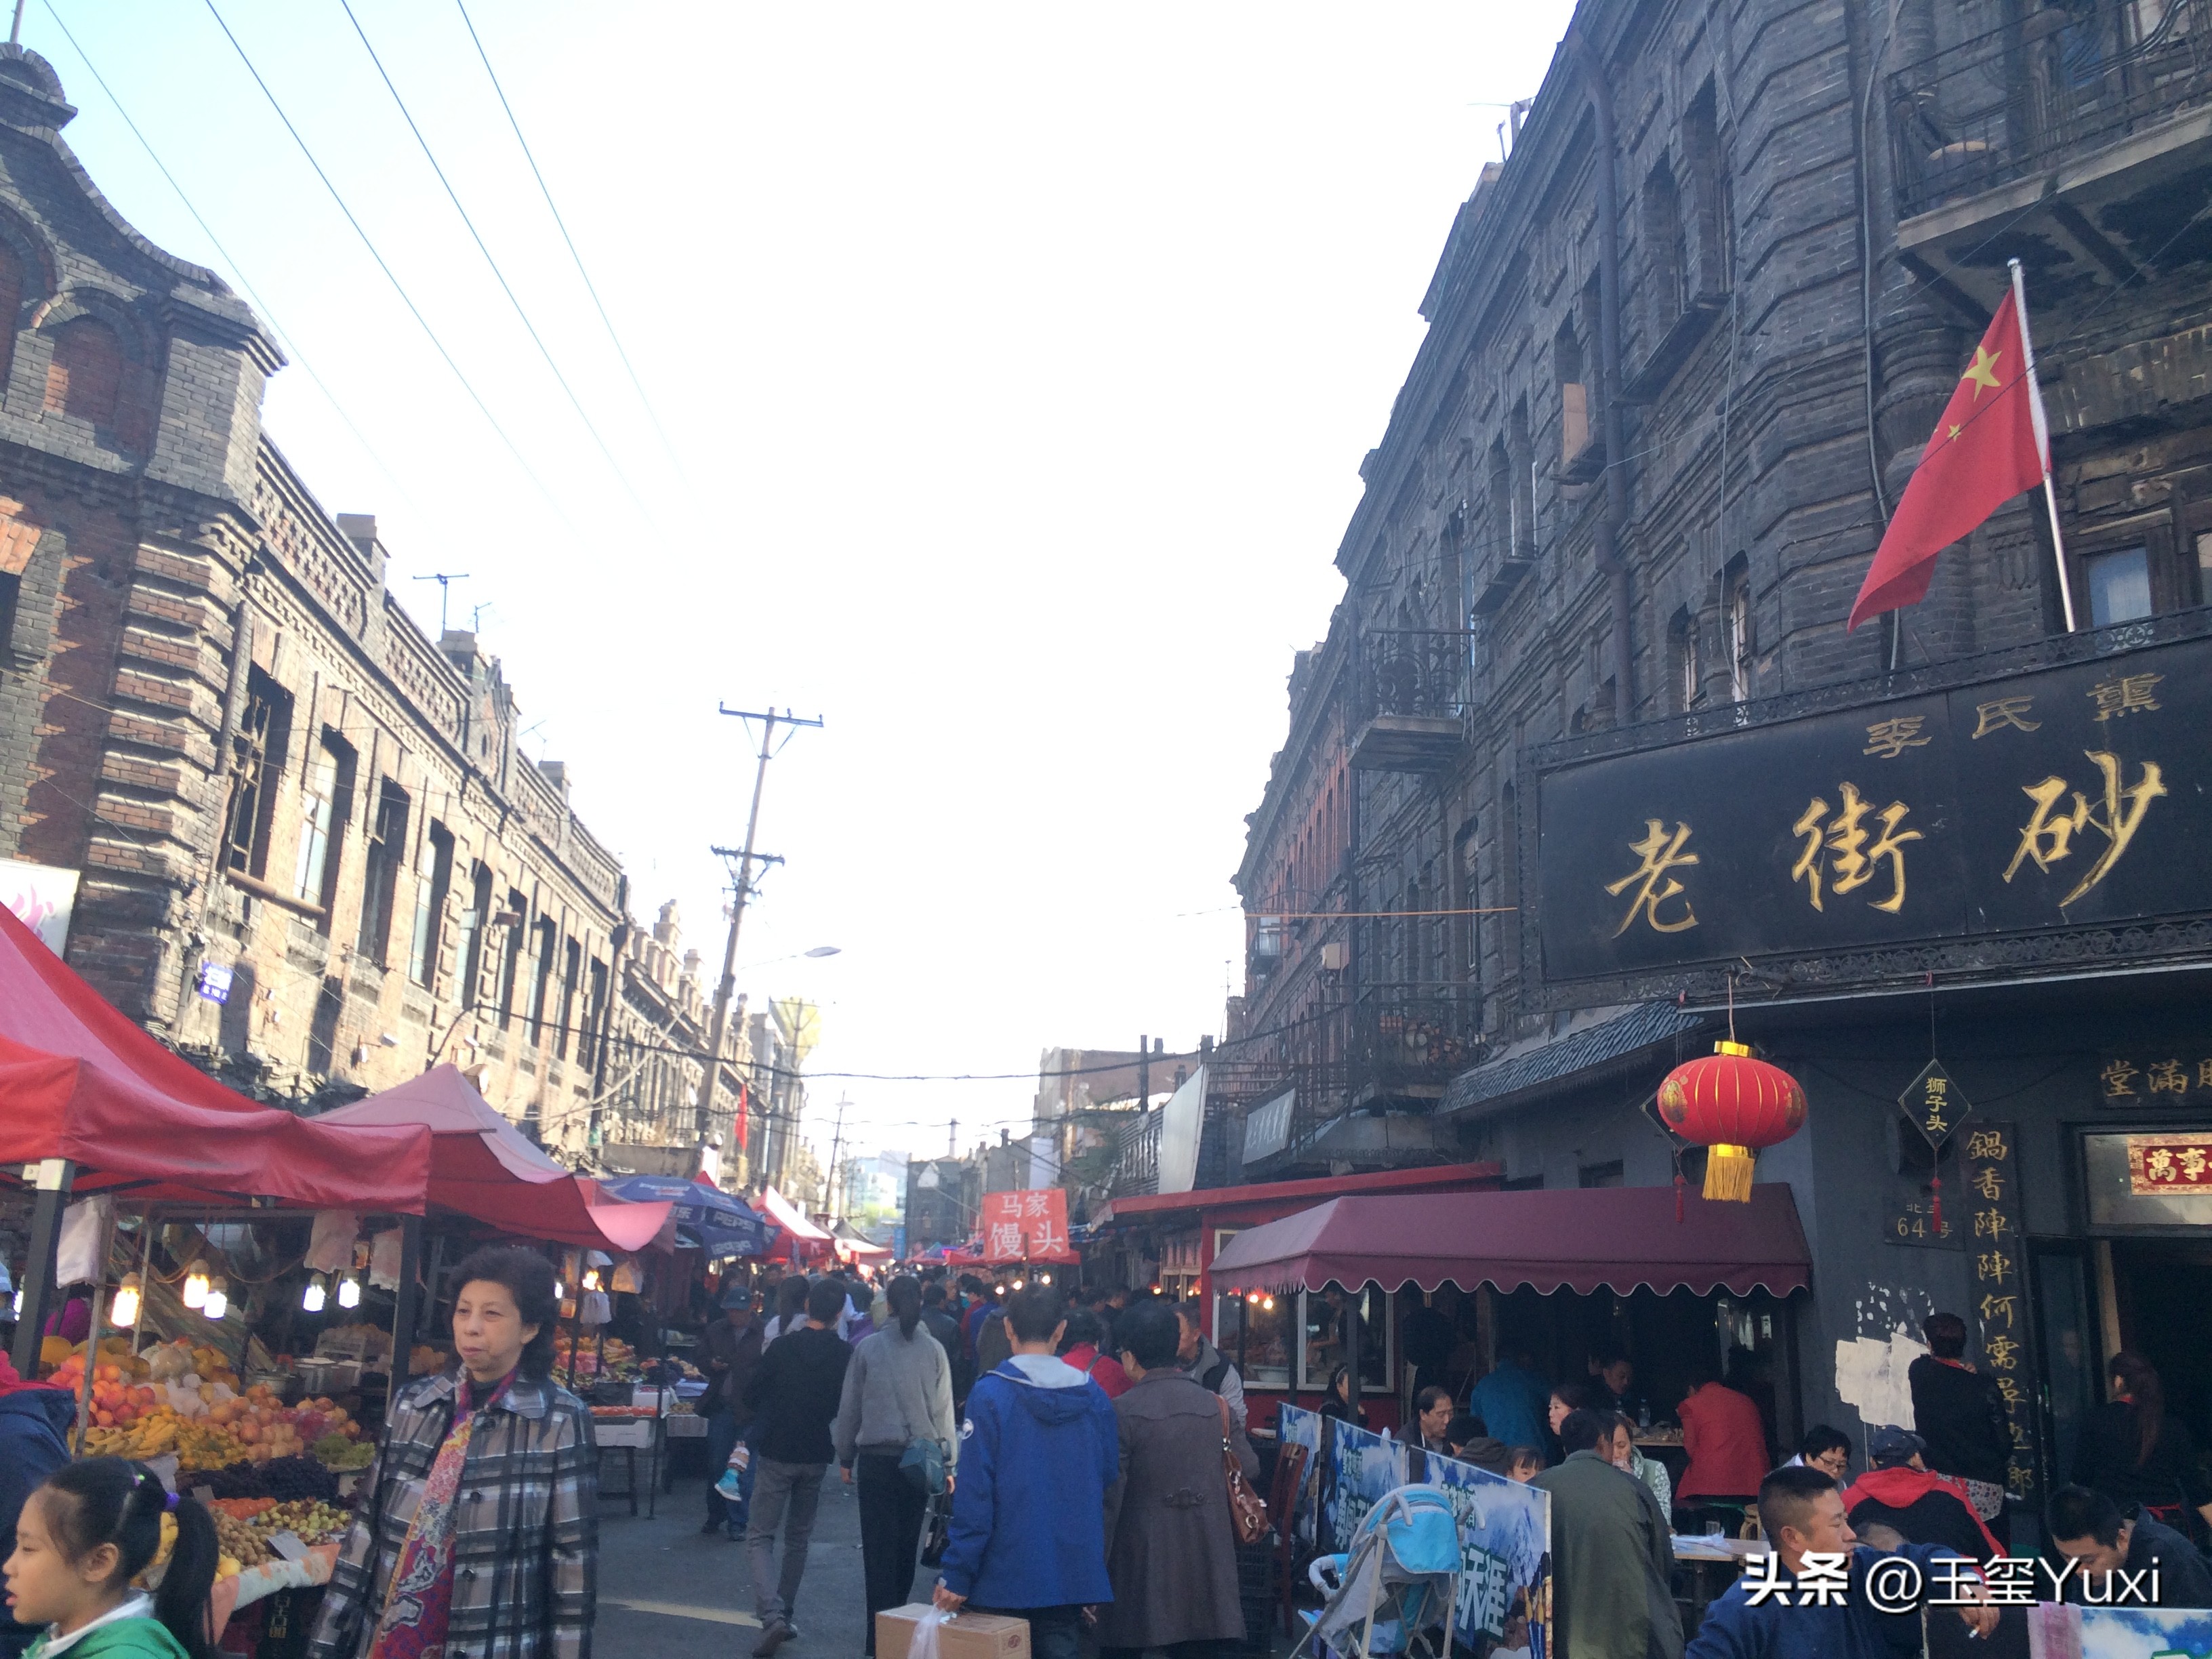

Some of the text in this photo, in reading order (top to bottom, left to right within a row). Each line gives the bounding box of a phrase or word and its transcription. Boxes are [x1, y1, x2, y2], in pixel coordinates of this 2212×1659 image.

[1605, 750, 2167, 939] 老街砂
[1925, 1077, 1948, 1132] 狮子头
[2146, 1147, 2212, 1182] 萬事
[1001, 1192, 1050, 1218] 马家
[990, 1220, 1063, 1258] 馒头
